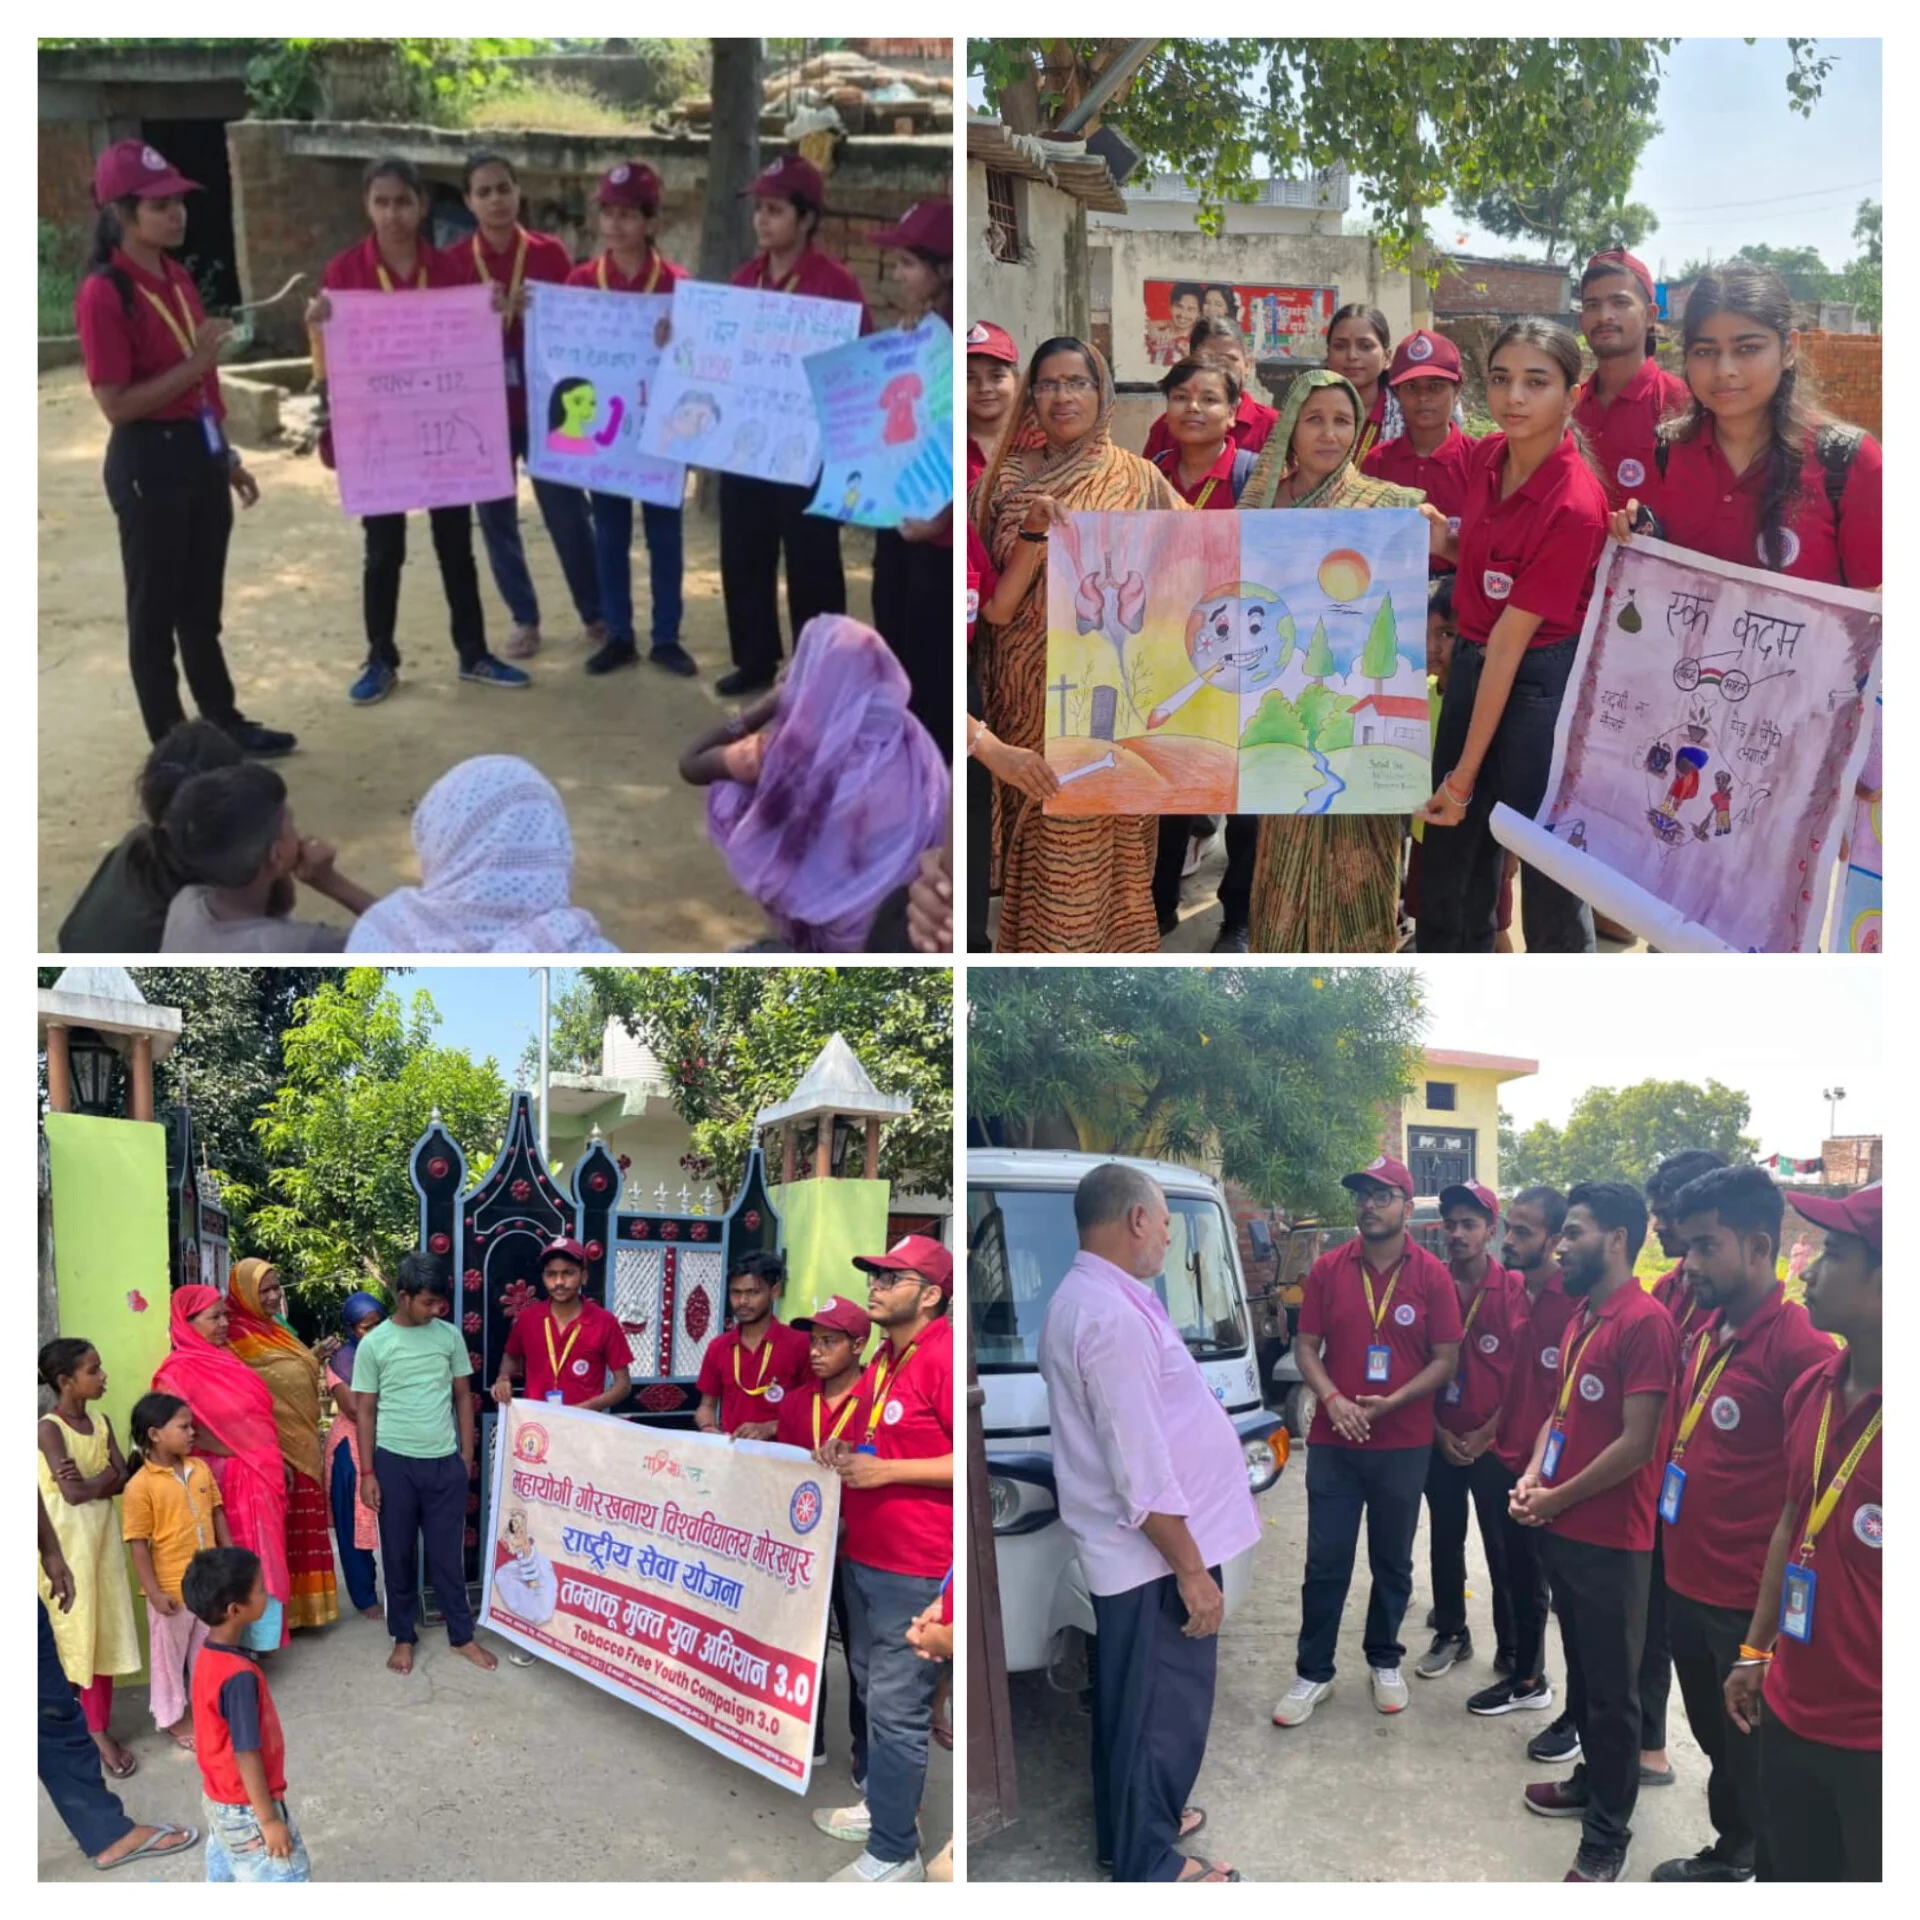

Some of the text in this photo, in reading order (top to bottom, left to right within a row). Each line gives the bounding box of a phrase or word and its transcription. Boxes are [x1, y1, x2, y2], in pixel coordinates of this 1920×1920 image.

[421, 421, 460, 456] 112
[1667, 591, 1806, 660] एक कदम
[513, 1470, 815, 1586] महायोगी गोरखनाथ विश्वविद्यालय गोरखपुर
[562, 1526, 744, 1609] राष्ट्रीय सेवा योजना
[560, 1577, 810, 1707] तम्बाकू मुक्त युवा अभियान 3.0
[573, 1624, 624, 1659] Tobacco
[625, 1646, 652, 1671] Free
[654, 1658, 689, 1691] Youth
[758, 1710, 780, 1736] 3.0
